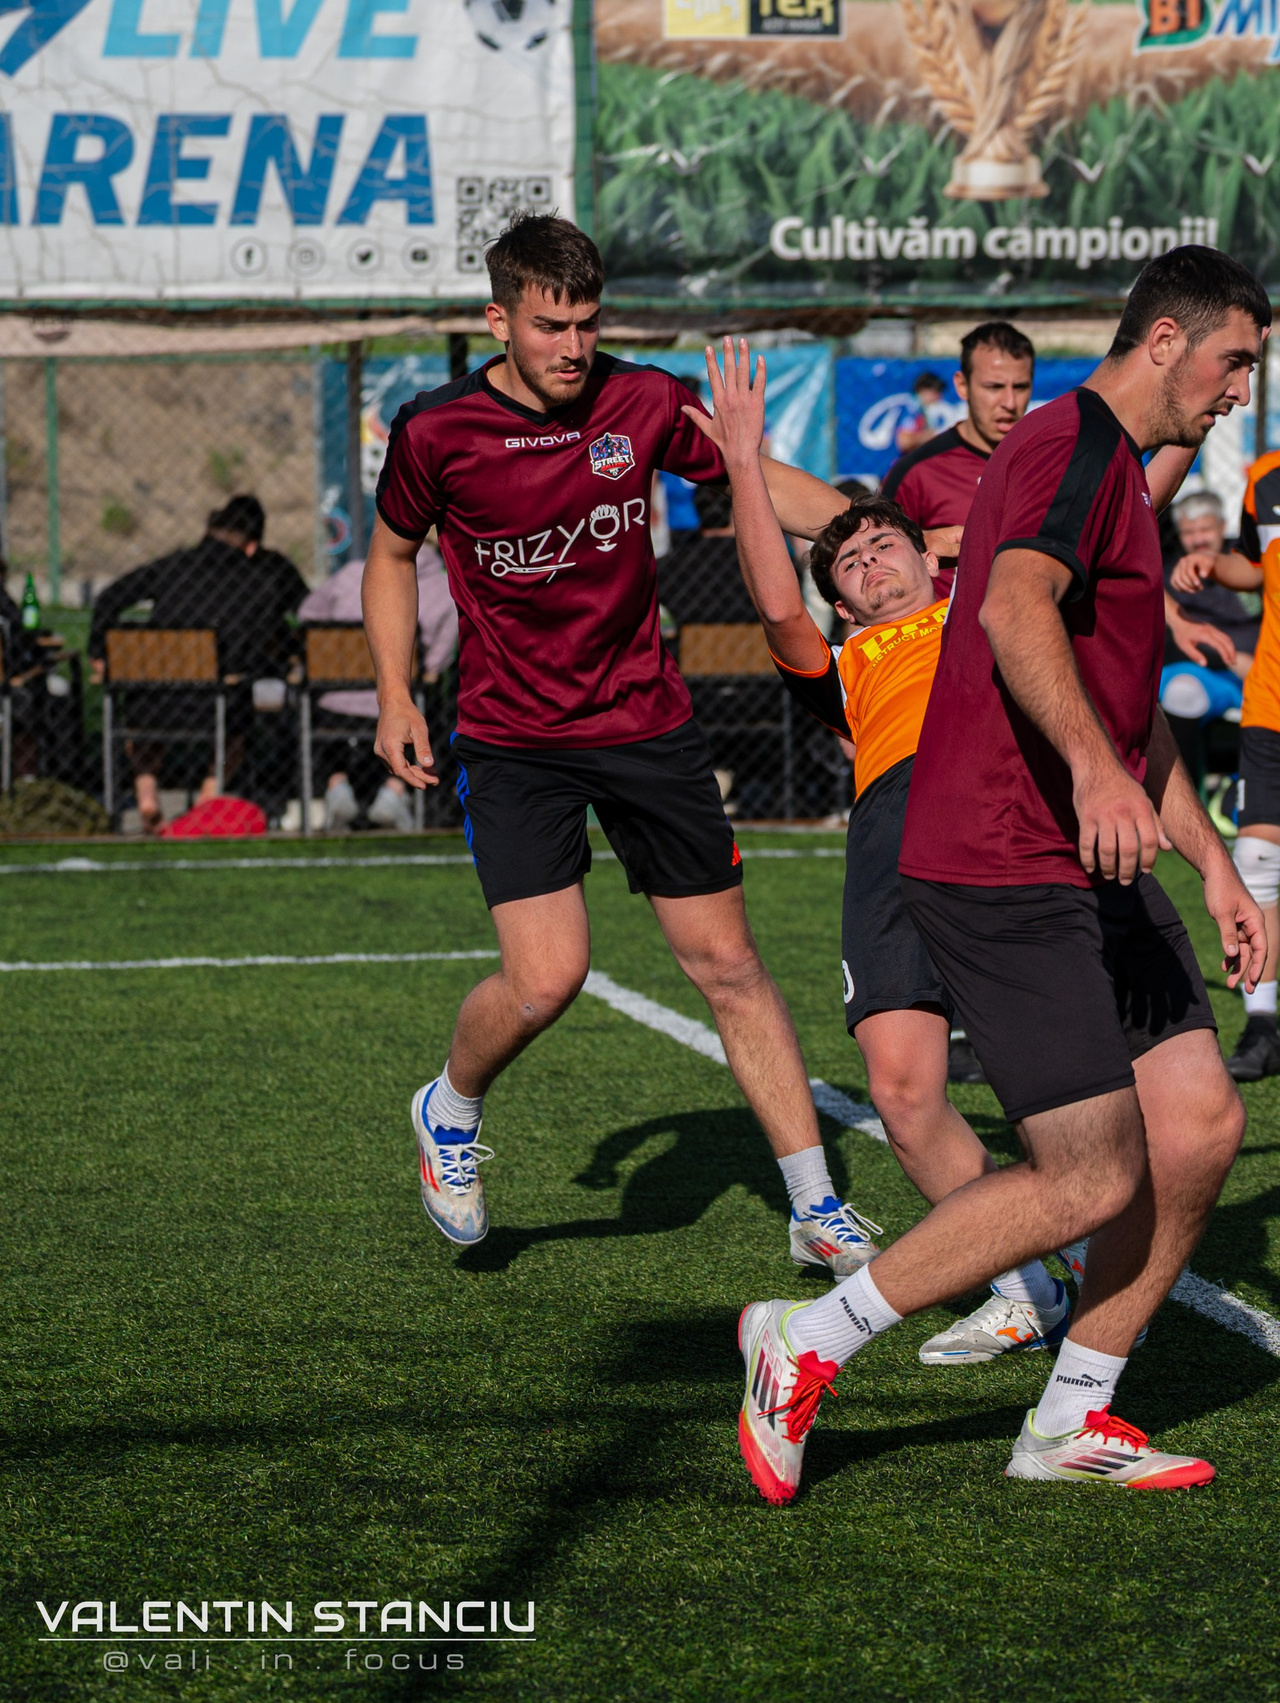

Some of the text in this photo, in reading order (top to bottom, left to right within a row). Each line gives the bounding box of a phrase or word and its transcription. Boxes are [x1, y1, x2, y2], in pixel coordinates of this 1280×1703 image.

[0, 112, 436, 226] RENA
[769, 214, 979, 263] Cultivăm
[504, 431, 582, 449] GIVOVA
